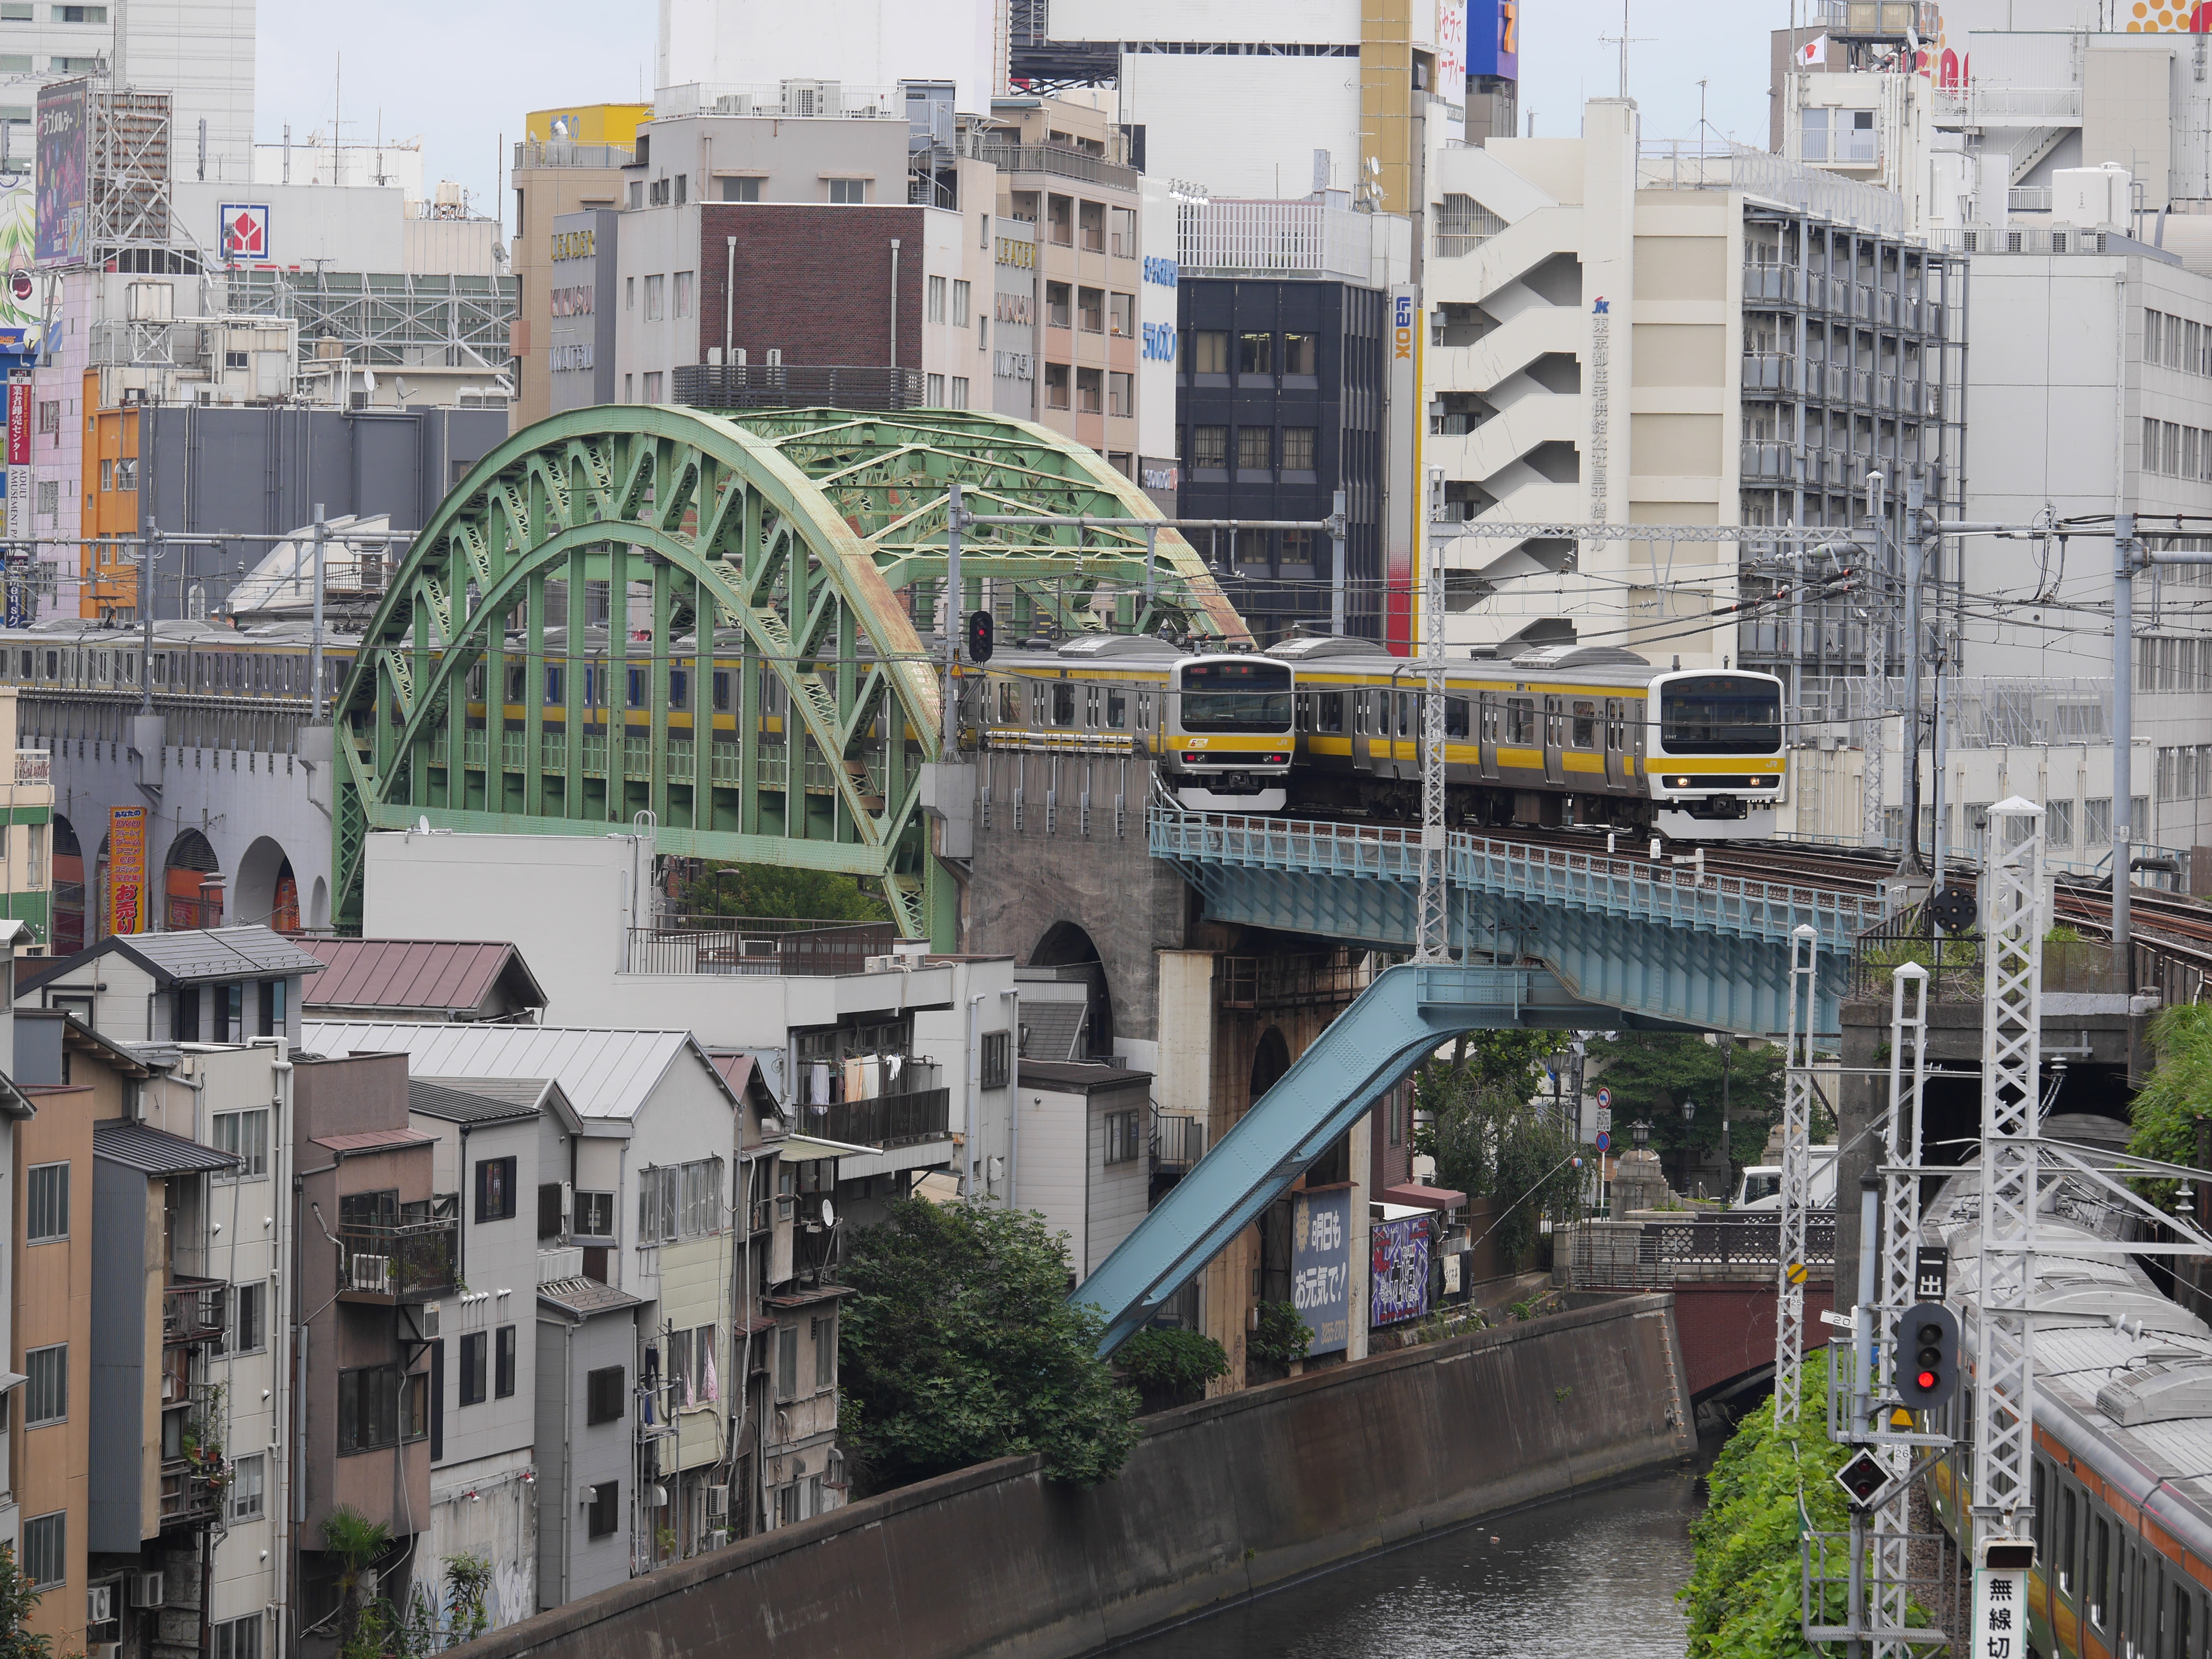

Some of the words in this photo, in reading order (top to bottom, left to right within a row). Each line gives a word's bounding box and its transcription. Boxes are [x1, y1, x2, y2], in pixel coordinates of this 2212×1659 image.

[1439, 50, 1465, 85] ーティー
[43, 109, 72, 136] ラブメルシー
[551, 230, 595, 261] LEADER
[995, 236, 1036, 270] LEADER
[12, 385, 23, 461] 業者卸売センター
[115, 810, 141, 818] あなたの
[115, 883, 138, 935] お売り
[1312, 1210, 1341, 1252] 明日も
[1295, 1262, 1346, 1310] お元気で!
[1833, 1316, 1850, 1326] 20
[1896, 1450, 1909, 1458] 26
[1987, 1578, 2013, 1659] 無線切
